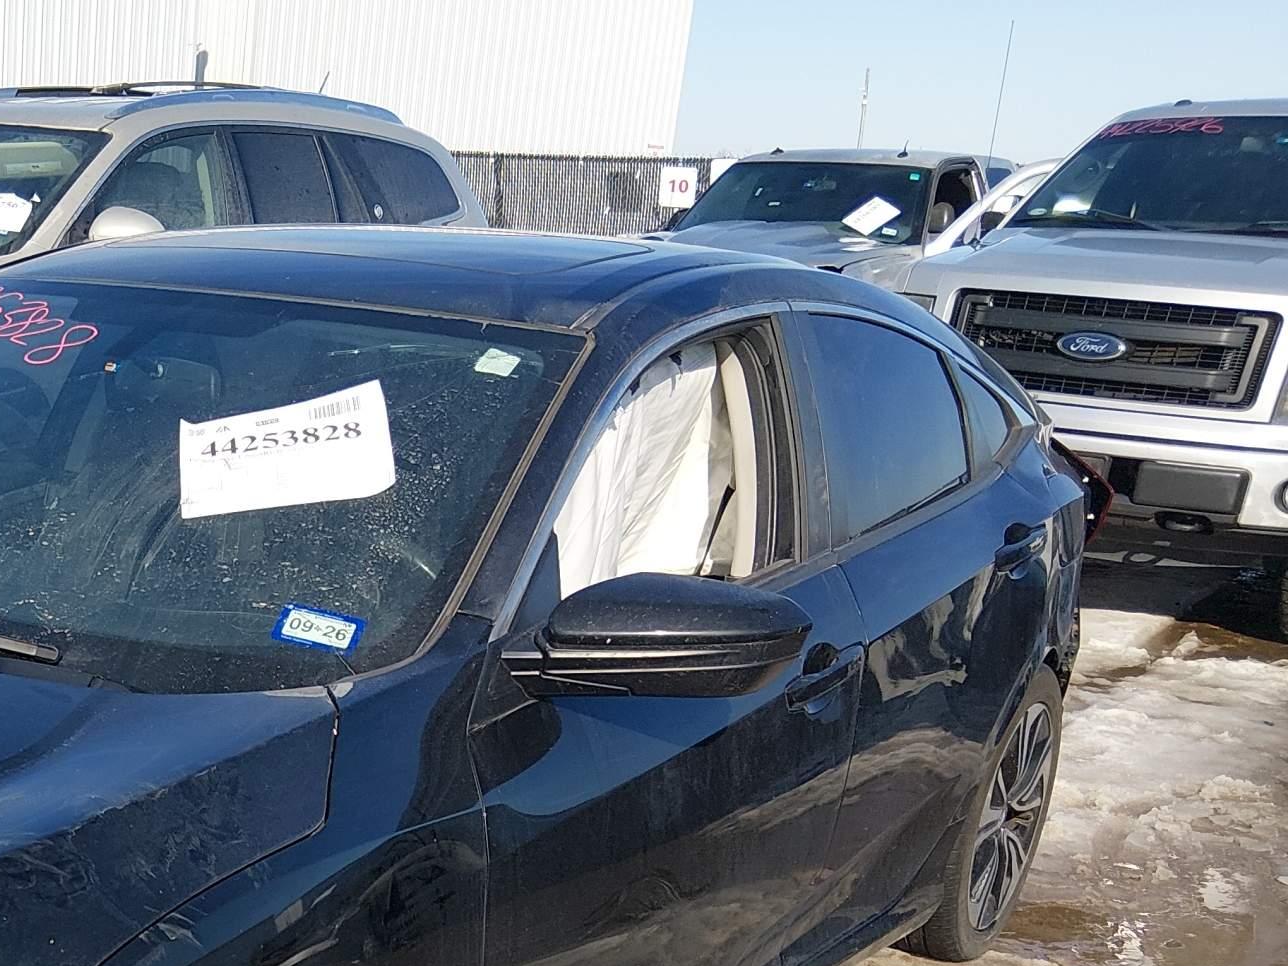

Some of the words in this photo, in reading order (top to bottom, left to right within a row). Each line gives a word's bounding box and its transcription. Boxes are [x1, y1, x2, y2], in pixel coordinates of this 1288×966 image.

[668, 179, 689, 194] 10
[1070, 336, 1110, 354] Ford
[200, 421, 362, 457] 44253828
